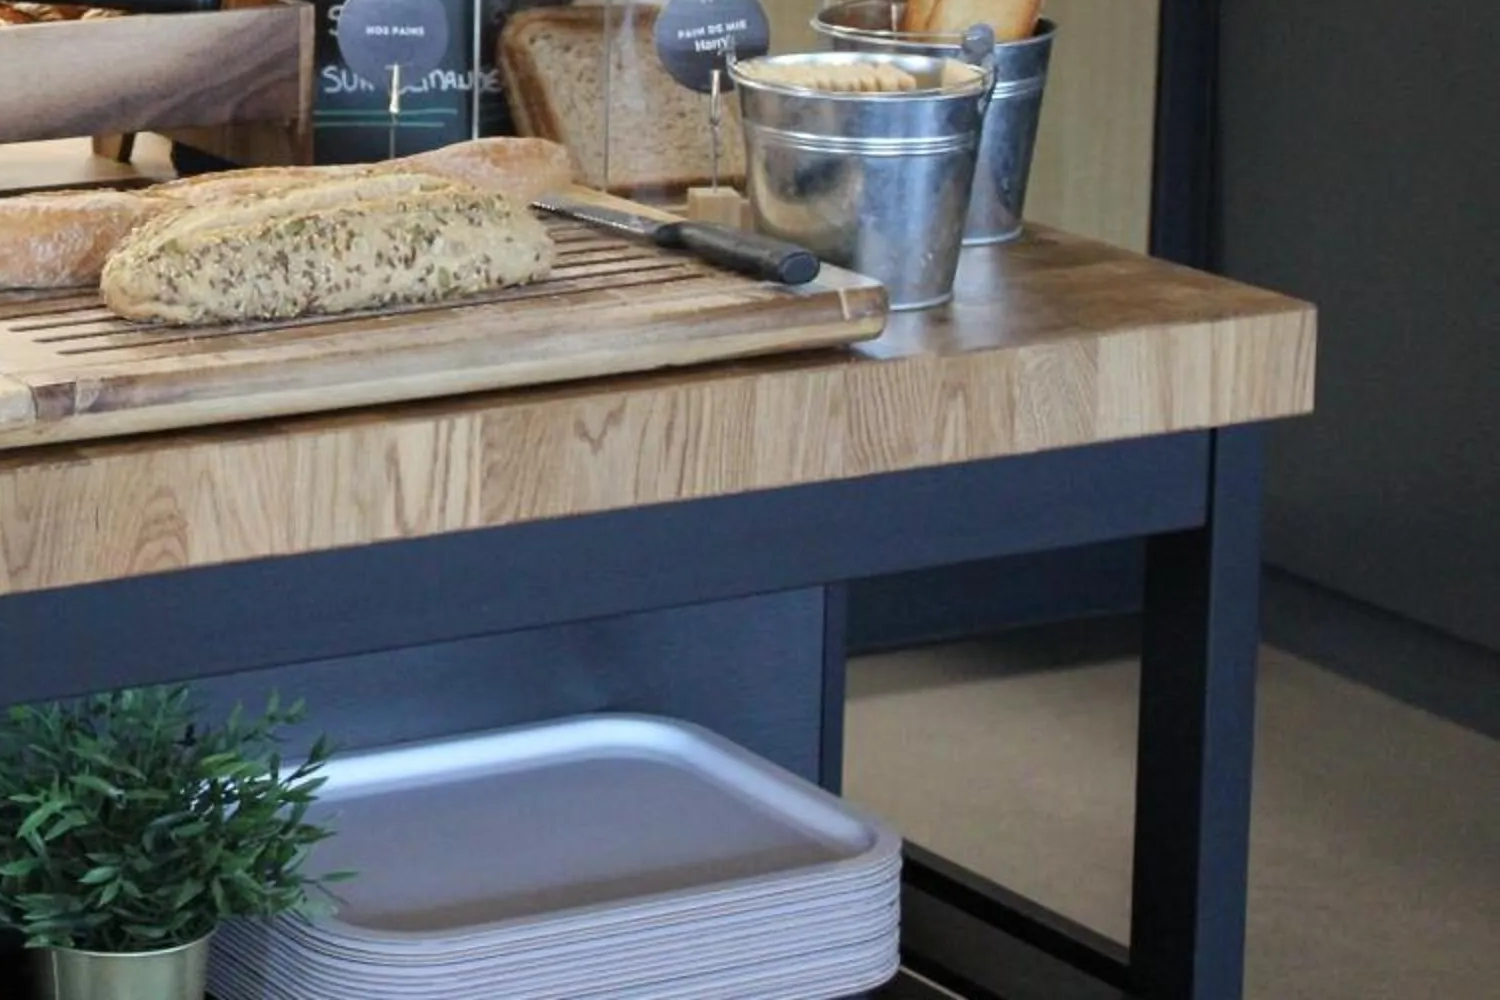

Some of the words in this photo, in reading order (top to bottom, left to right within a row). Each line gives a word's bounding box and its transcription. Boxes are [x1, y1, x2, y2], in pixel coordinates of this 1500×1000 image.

[366, 25, 389, 37] NOS
[392, 25, 426, 38] PAINS
[677, 26, 706, 40] PAIN
[707, 22, 724, 35] DE
[725, 18, 748, 32] MIE
